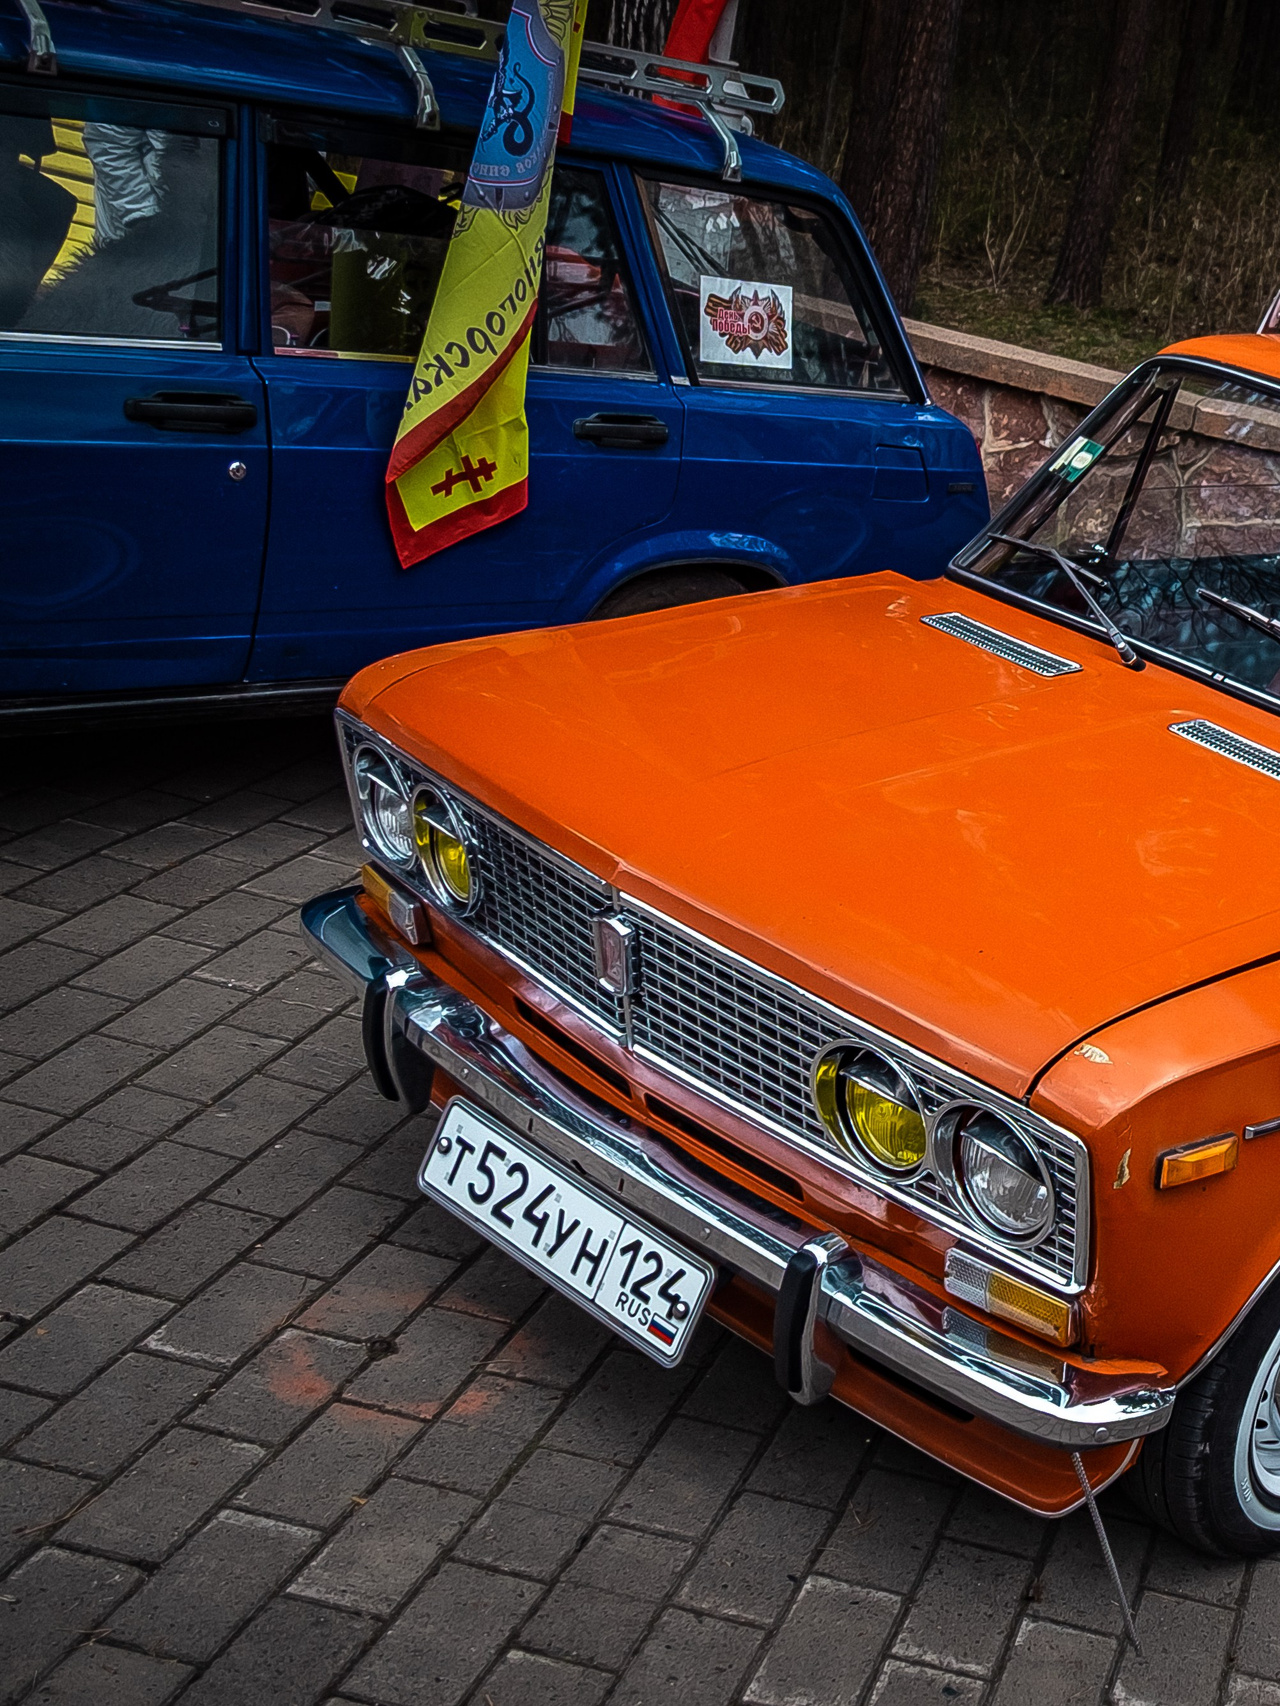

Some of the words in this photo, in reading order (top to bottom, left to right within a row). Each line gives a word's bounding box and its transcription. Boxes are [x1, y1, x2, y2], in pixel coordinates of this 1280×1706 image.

[711, 318, 751, 336] Победы
[717, 307, 738, 321] День
[447, 1135, 610, 1287] Т524УН
[619, 1238, 688, 1321] 124
[615, 1291, 652, 1328] RUS
